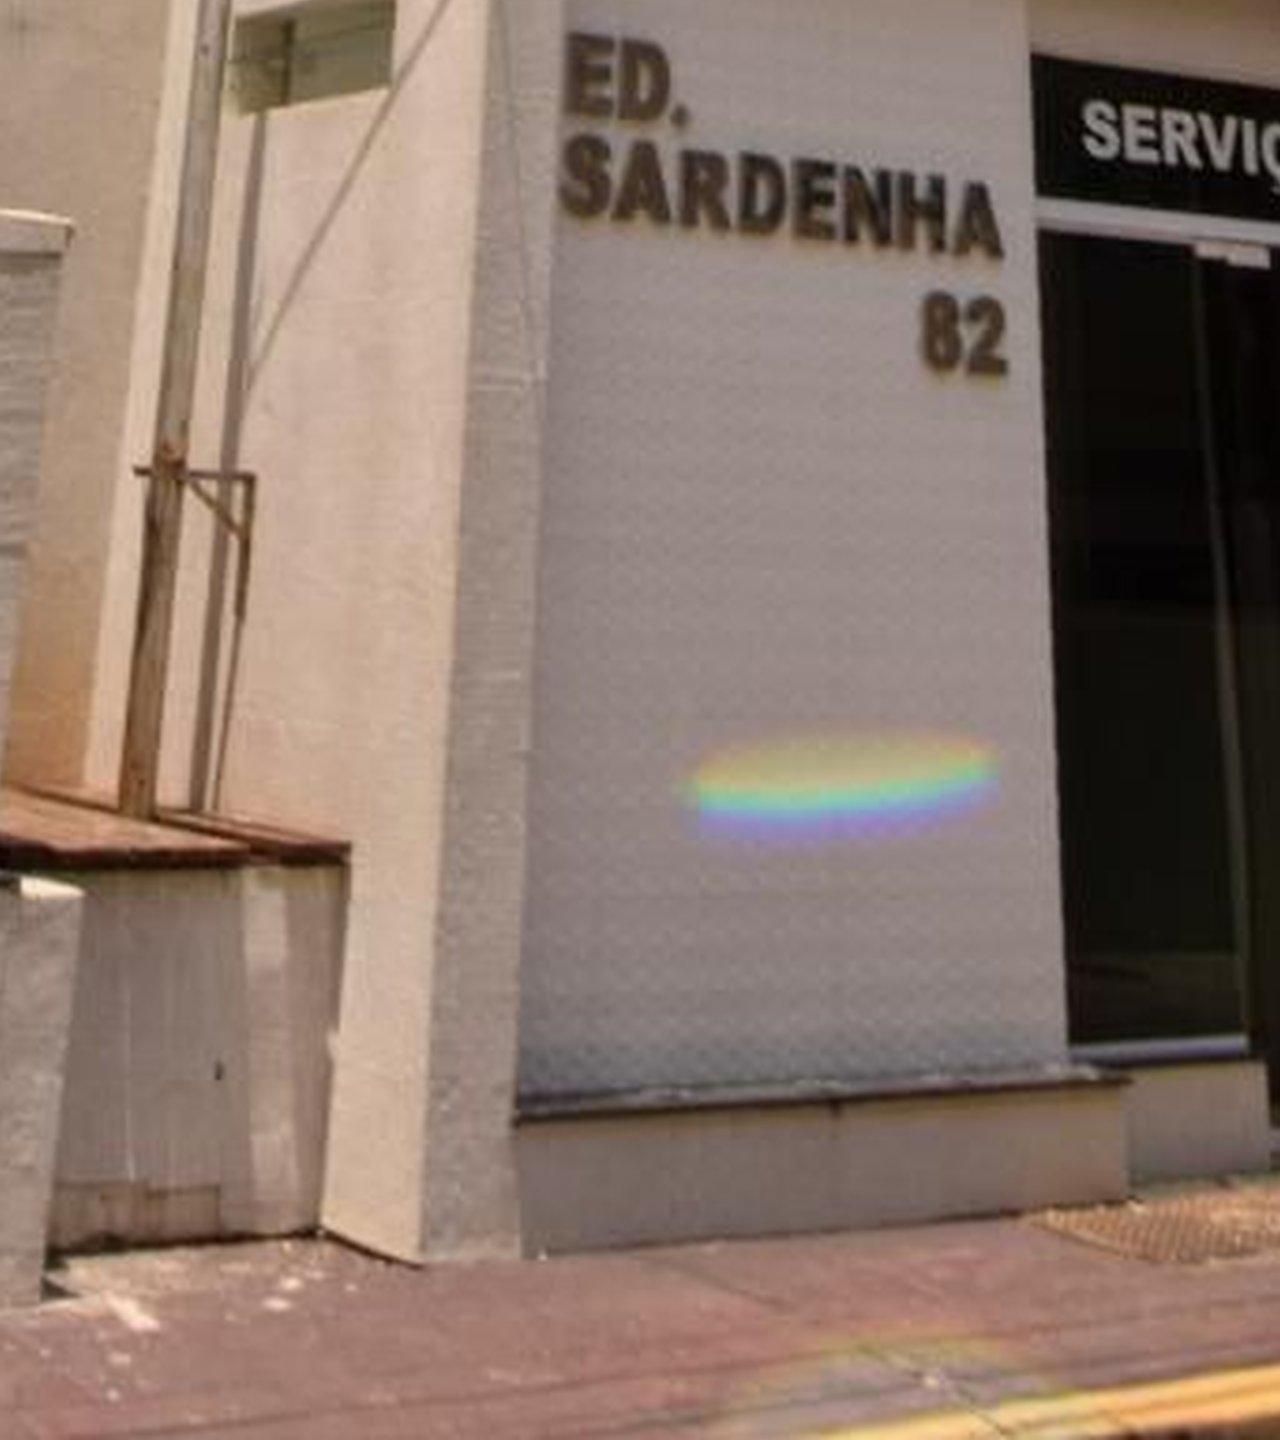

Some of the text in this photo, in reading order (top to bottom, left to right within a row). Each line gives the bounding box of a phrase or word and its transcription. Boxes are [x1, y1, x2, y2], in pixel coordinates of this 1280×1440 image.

[563, 32, 691, 127] ED.
[559, 134, 1005, 260] SARDENHA
[921, 289, 1009, 377] 82
